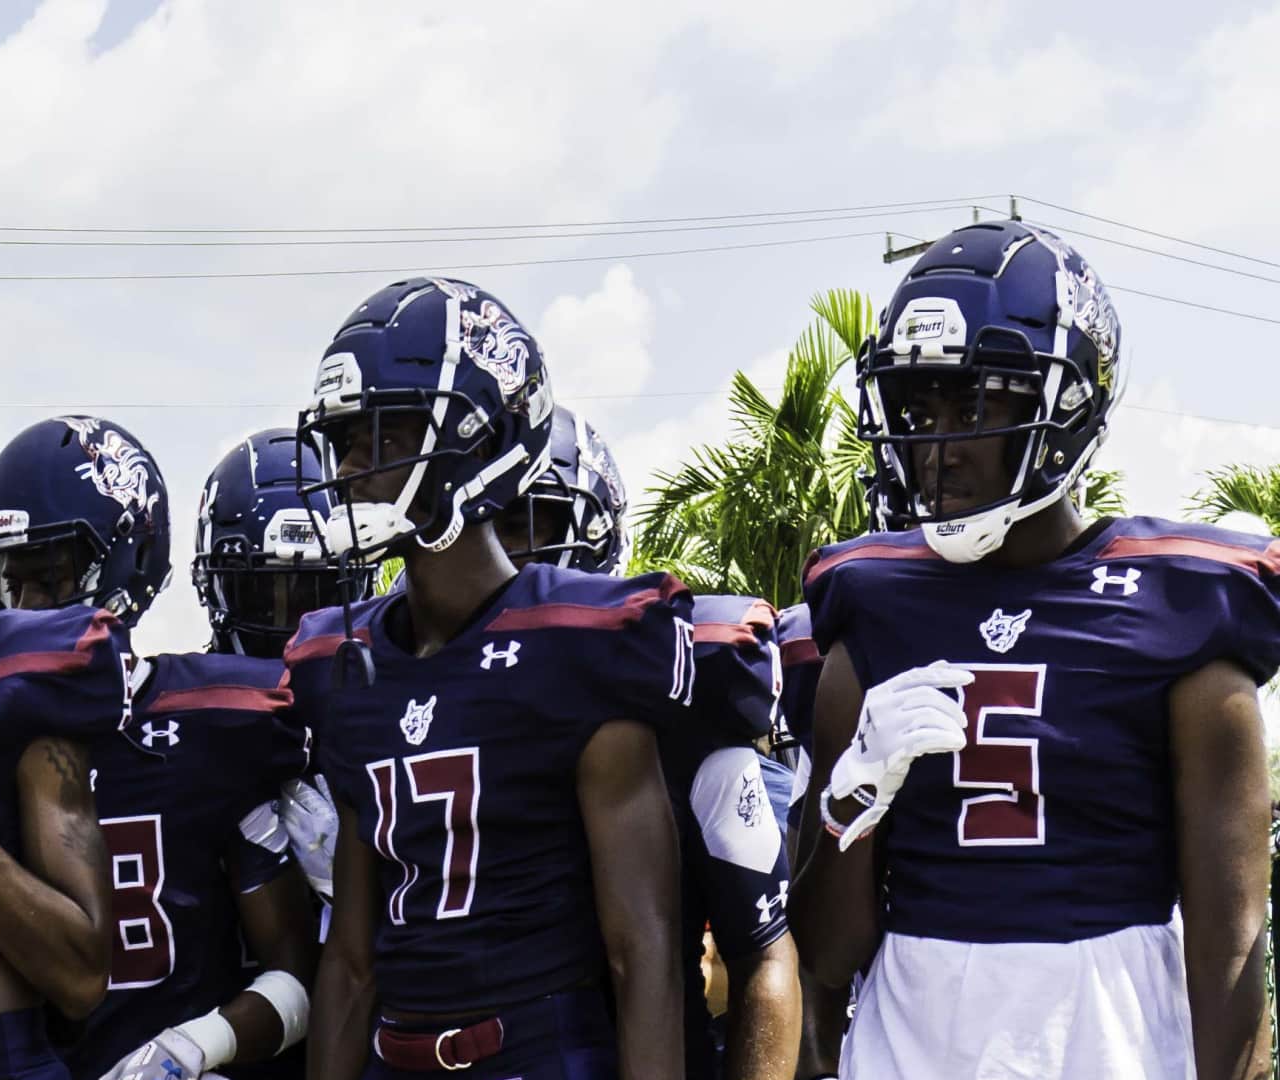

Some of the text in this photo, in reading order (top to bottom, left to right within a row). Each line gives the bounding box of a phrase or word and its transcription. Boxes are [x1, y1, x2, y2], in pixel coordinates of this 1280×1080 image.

[936, 522, 966, 537] schutt
[365, 746, 480, 925] 17
[953, 663, 1047, 847] 5
